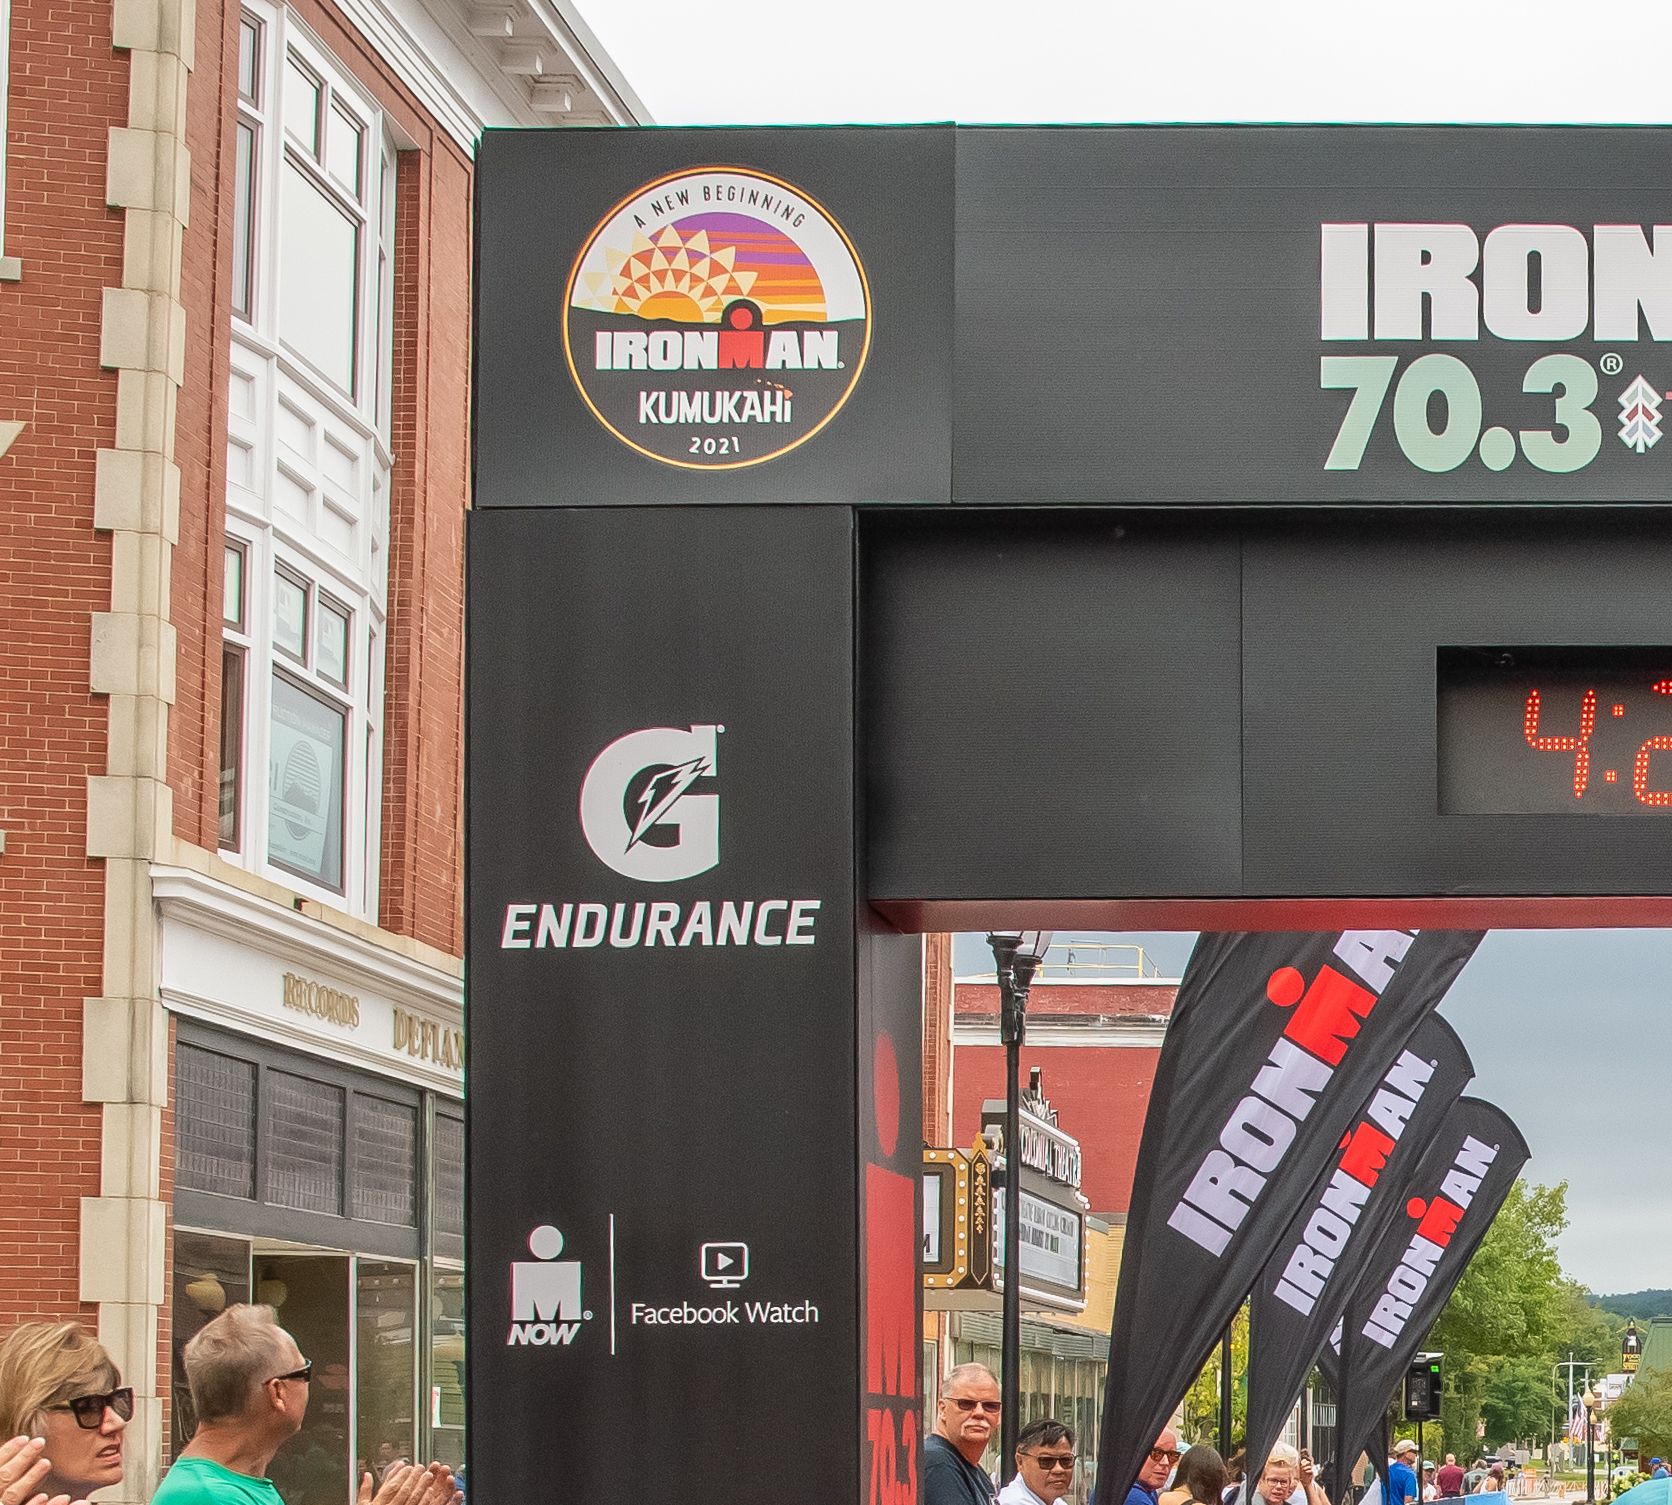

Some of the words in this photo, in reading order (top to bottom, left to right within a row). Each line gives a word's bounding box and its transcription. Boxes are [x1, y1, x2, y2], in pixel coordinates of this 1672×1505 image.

[633, 213, 646, 229] A
[650, 188, 690, 217] NEW
[703, 184, 807, 229] BEGINNING
[595, 307, 839, 370] IRONMAN
[1320, 353, 1603, 474] 70.3
[688, 436, 741, 456] 2021
[501, 899, 821, 949] ENDURANCE
[1166, 929, 1420, 1258] IRONMA
[1273, 1050, 1439, 1317] IRONMAN
[1361, 1134, 1500, 1349] IRONMAN
[507, 1323, 580, 1346] NOW
[631, 1302, 739, 1324] Facebook
[745, 1300, 819, 1323] Watch
